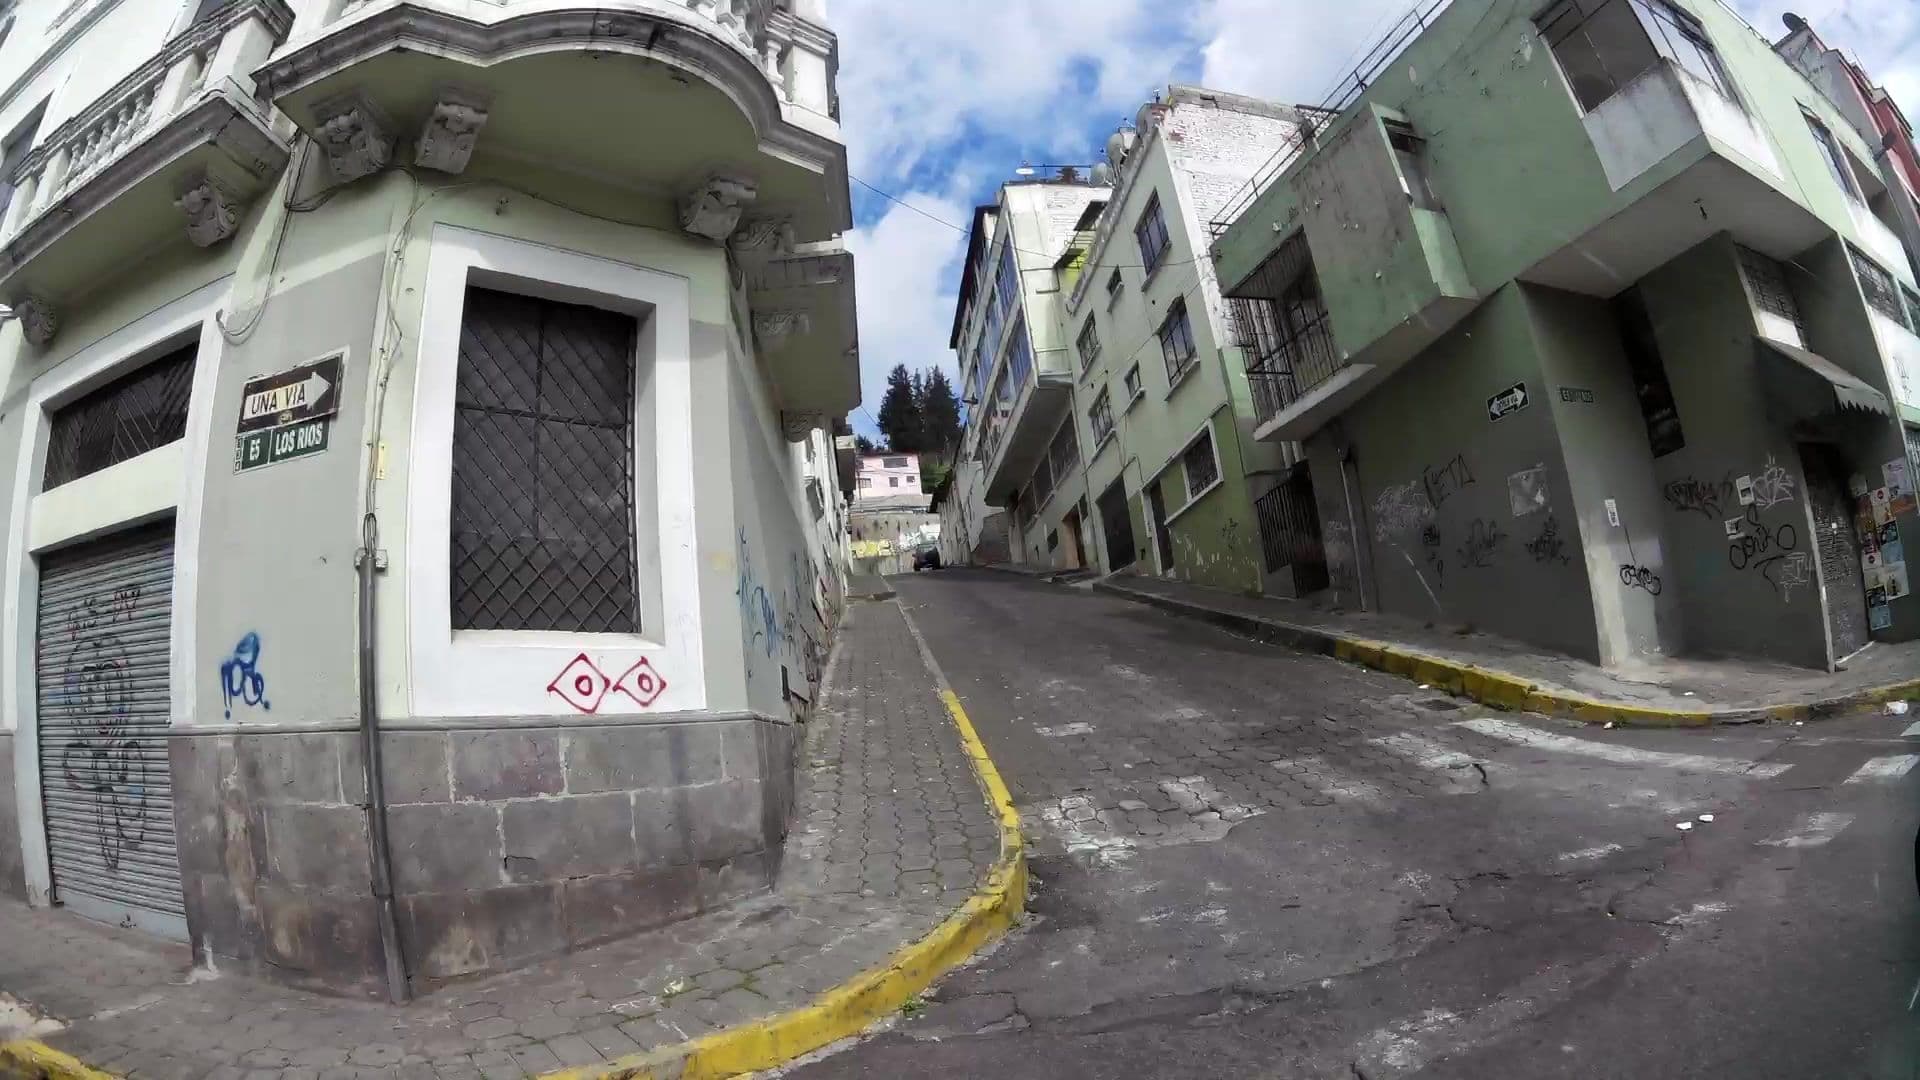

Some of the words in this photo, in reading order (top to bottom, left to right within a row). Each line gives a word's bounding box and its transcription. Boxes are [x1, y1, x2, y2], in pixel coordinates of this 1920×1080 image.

[251, 390, 278, 415] UNA
[285, 383, 305, 407] VIA
[249, 438, 260, 461] E5
[275, 429, 296, 456] LOS
[297, 422, 323, 450] RIOS
